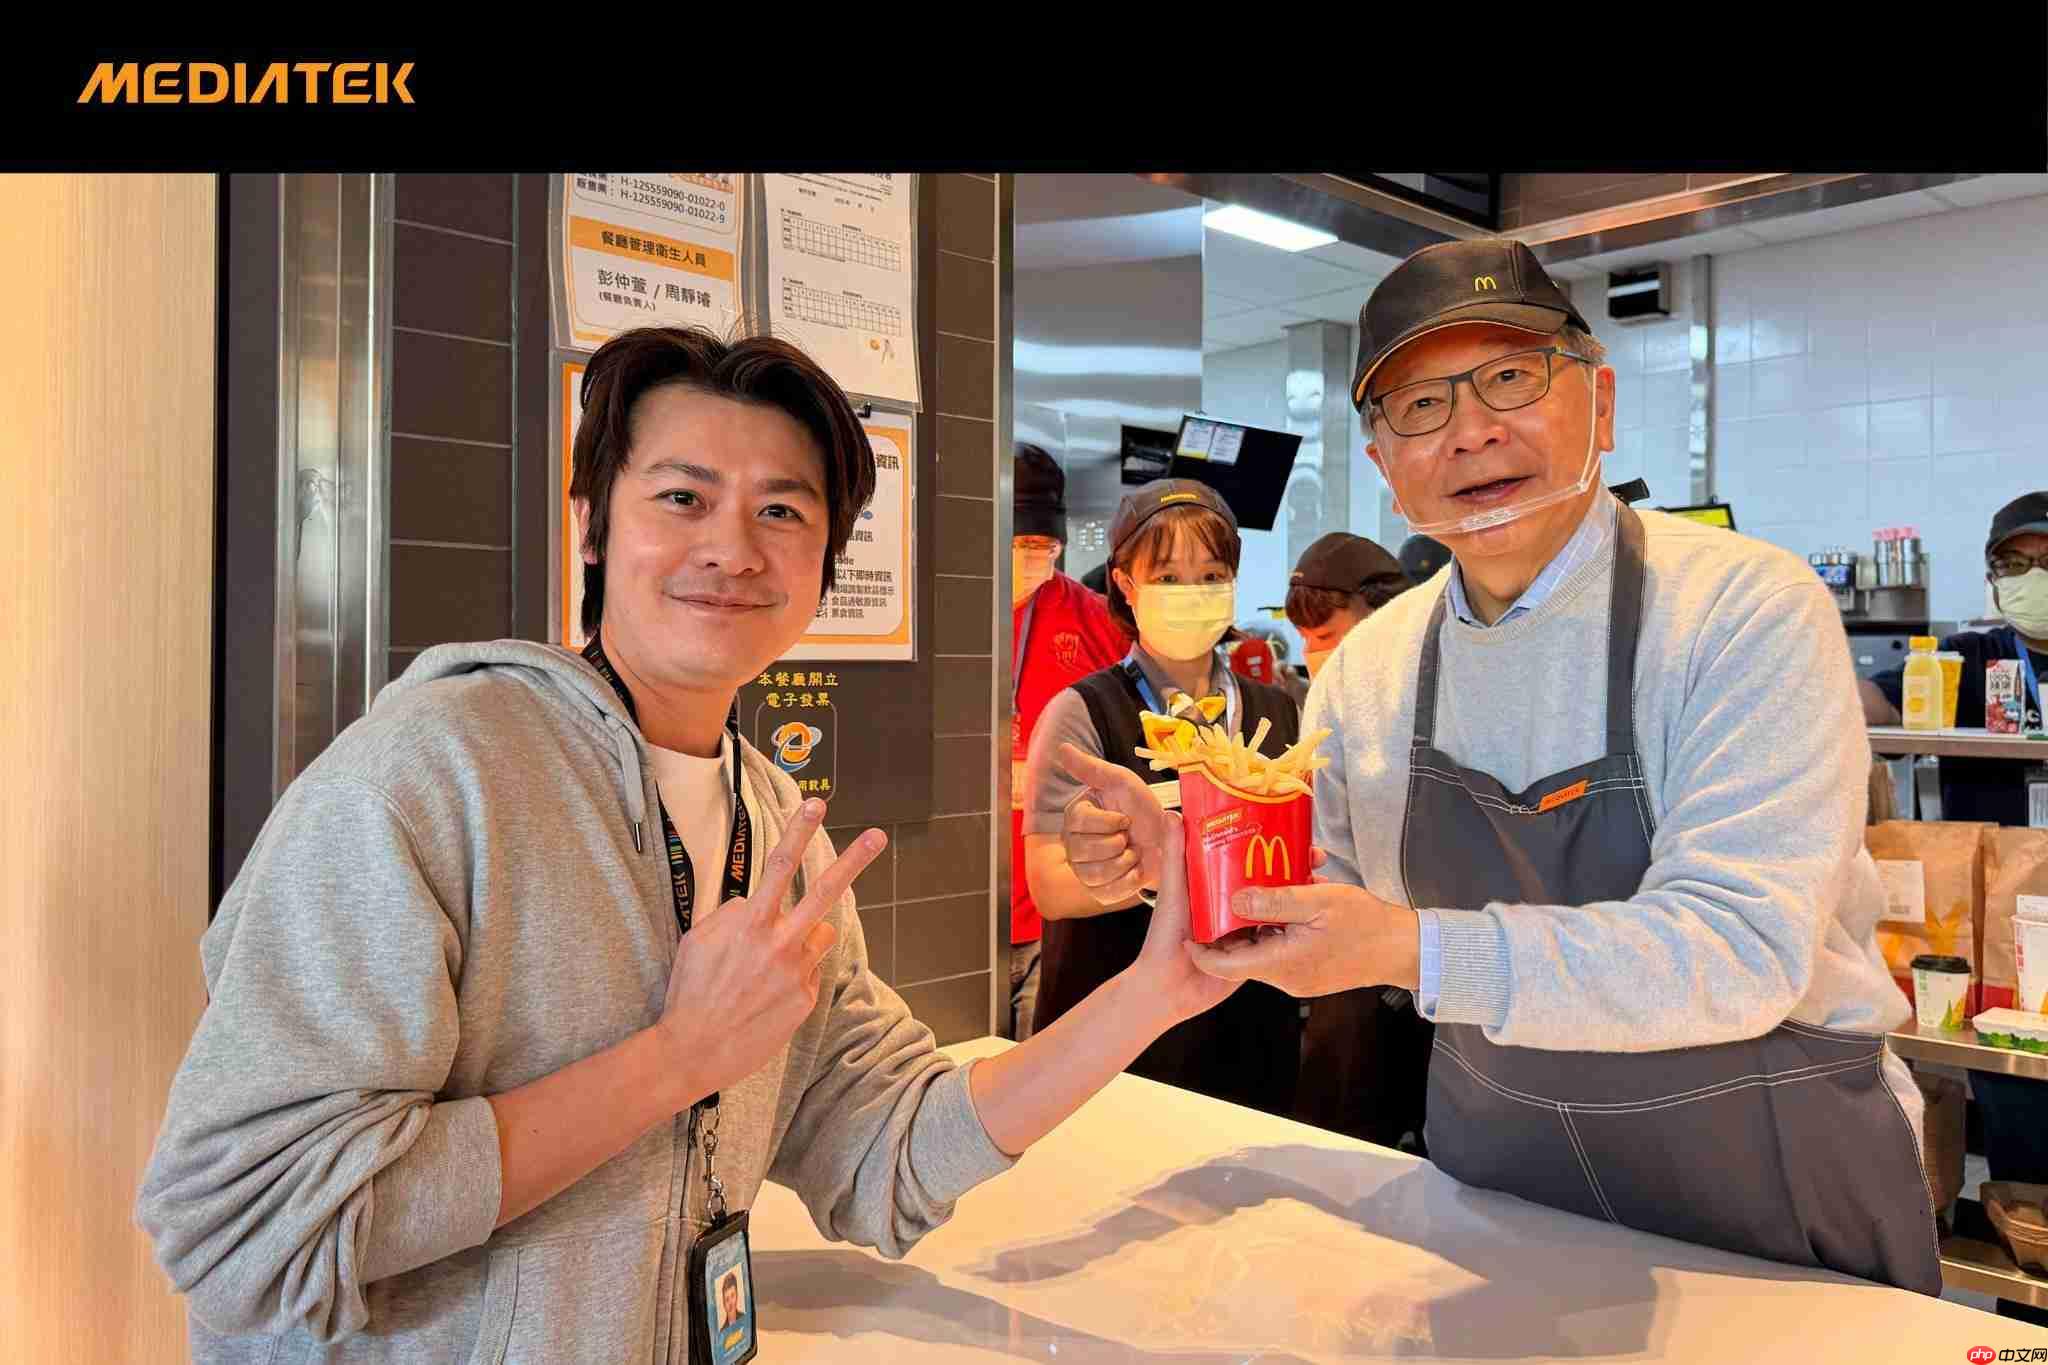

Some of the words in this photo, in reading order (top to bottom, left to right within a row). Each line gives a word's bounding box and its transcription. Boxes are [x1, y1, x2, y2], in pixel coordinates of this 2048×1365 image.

[601, 230, 707, 268] 餐廳管理衛生人員
[757, 671, 840, 688] 本餐廳開立
[766, 692, 832, 708] 電子發票
